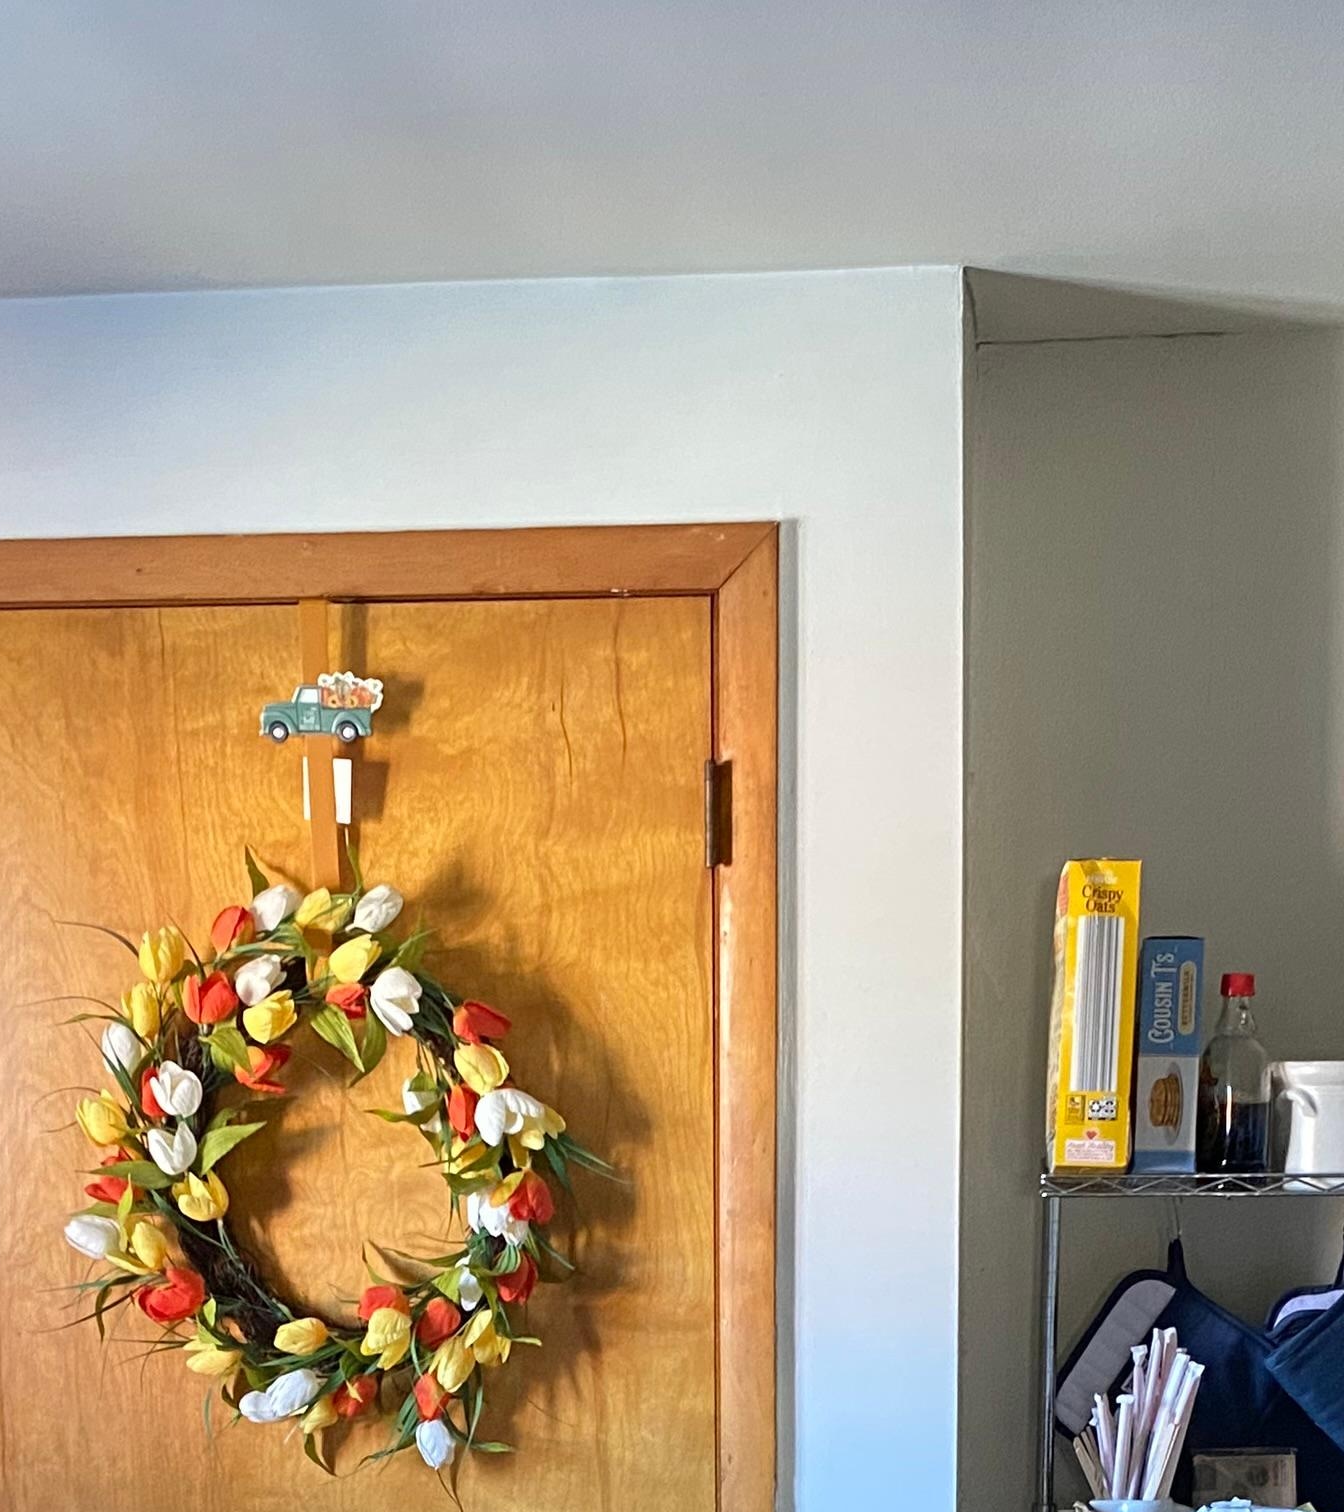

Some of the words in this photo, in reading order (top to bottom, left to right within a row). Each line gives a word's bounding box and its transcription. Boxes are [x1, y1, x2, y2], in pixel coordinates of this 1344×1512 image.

[1082, 884, 1124, 904] Crispy
[1086, 899, 1116, 913] Oats
[1148, 982, 1174, 1044] COUSIN
